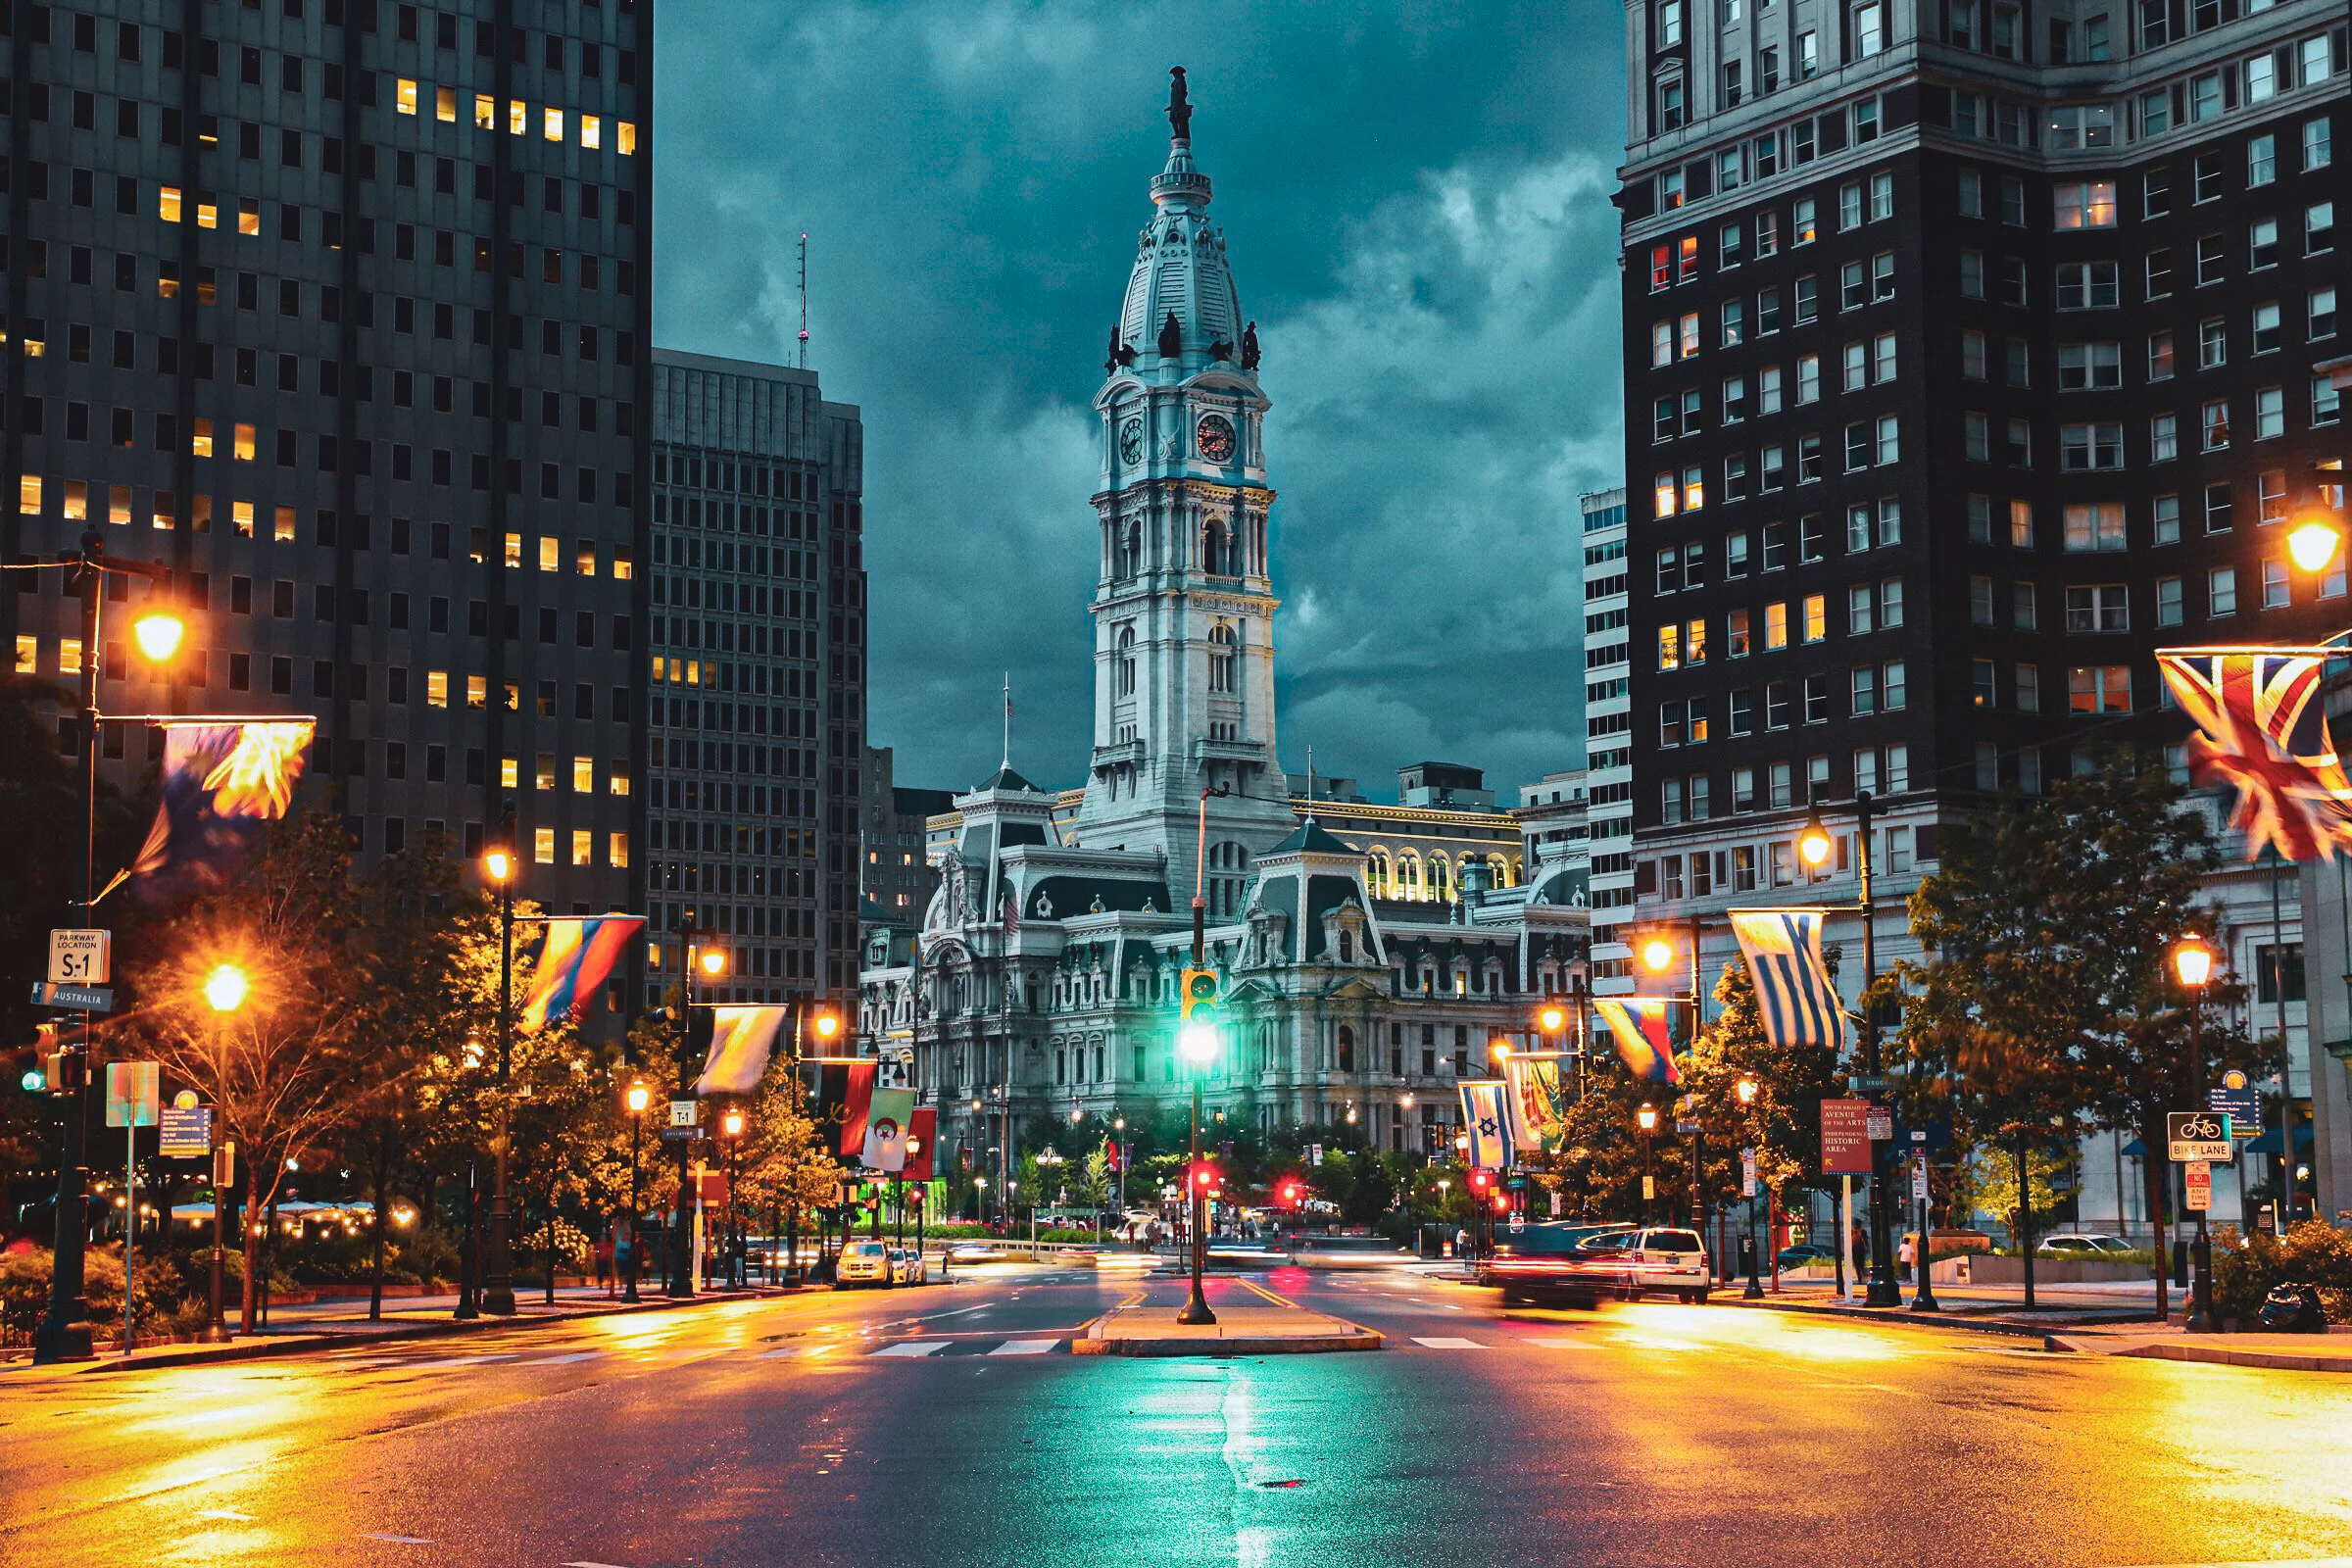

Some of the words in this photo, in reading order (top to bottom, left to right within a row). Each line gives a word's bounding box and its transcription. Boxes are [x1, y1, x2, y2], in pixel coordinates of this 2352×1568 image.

[62, 953, 90, 976] S-1
[53, 991, 101, 1004] AUSTRALIA
[676, 1111, 689, 1123] T-1
[2174, 1145, 2196, 1154] BIKE
[2200, 1146, 2227, 1154] LANE
